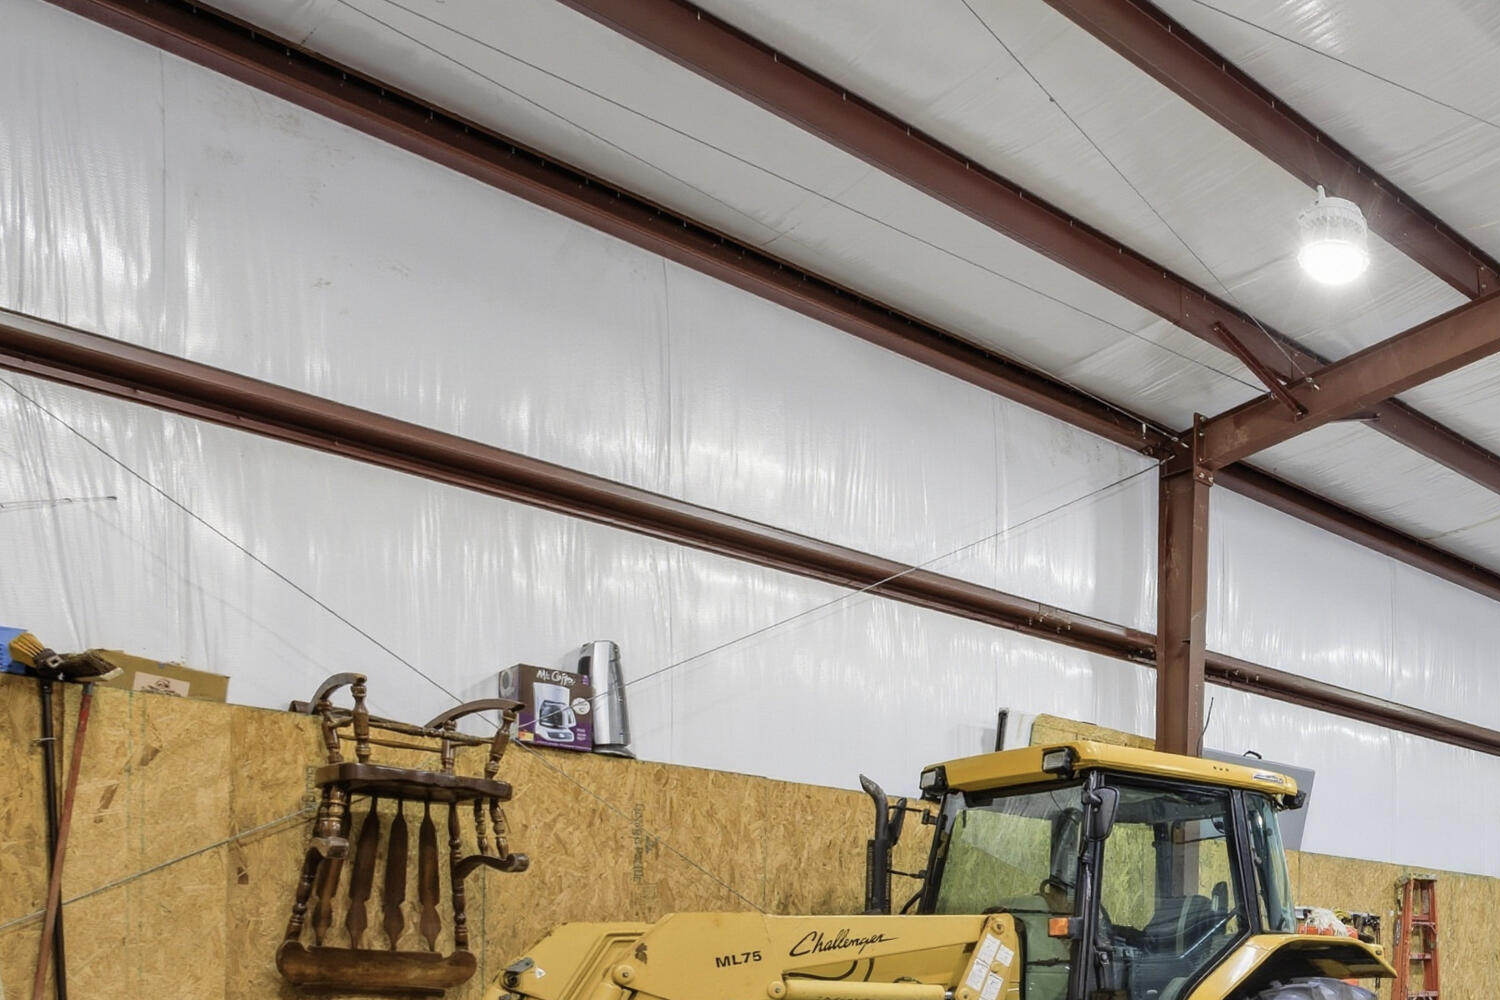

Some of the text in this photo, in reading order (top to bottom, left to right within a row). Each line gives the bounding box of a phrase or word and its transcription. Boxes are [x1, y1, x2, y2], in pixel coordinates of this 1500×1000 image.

[551, 671, 577, 686] Coffee
[788, 928, 900, 957] Challenger
[715, 950, 763, 968] ML75
